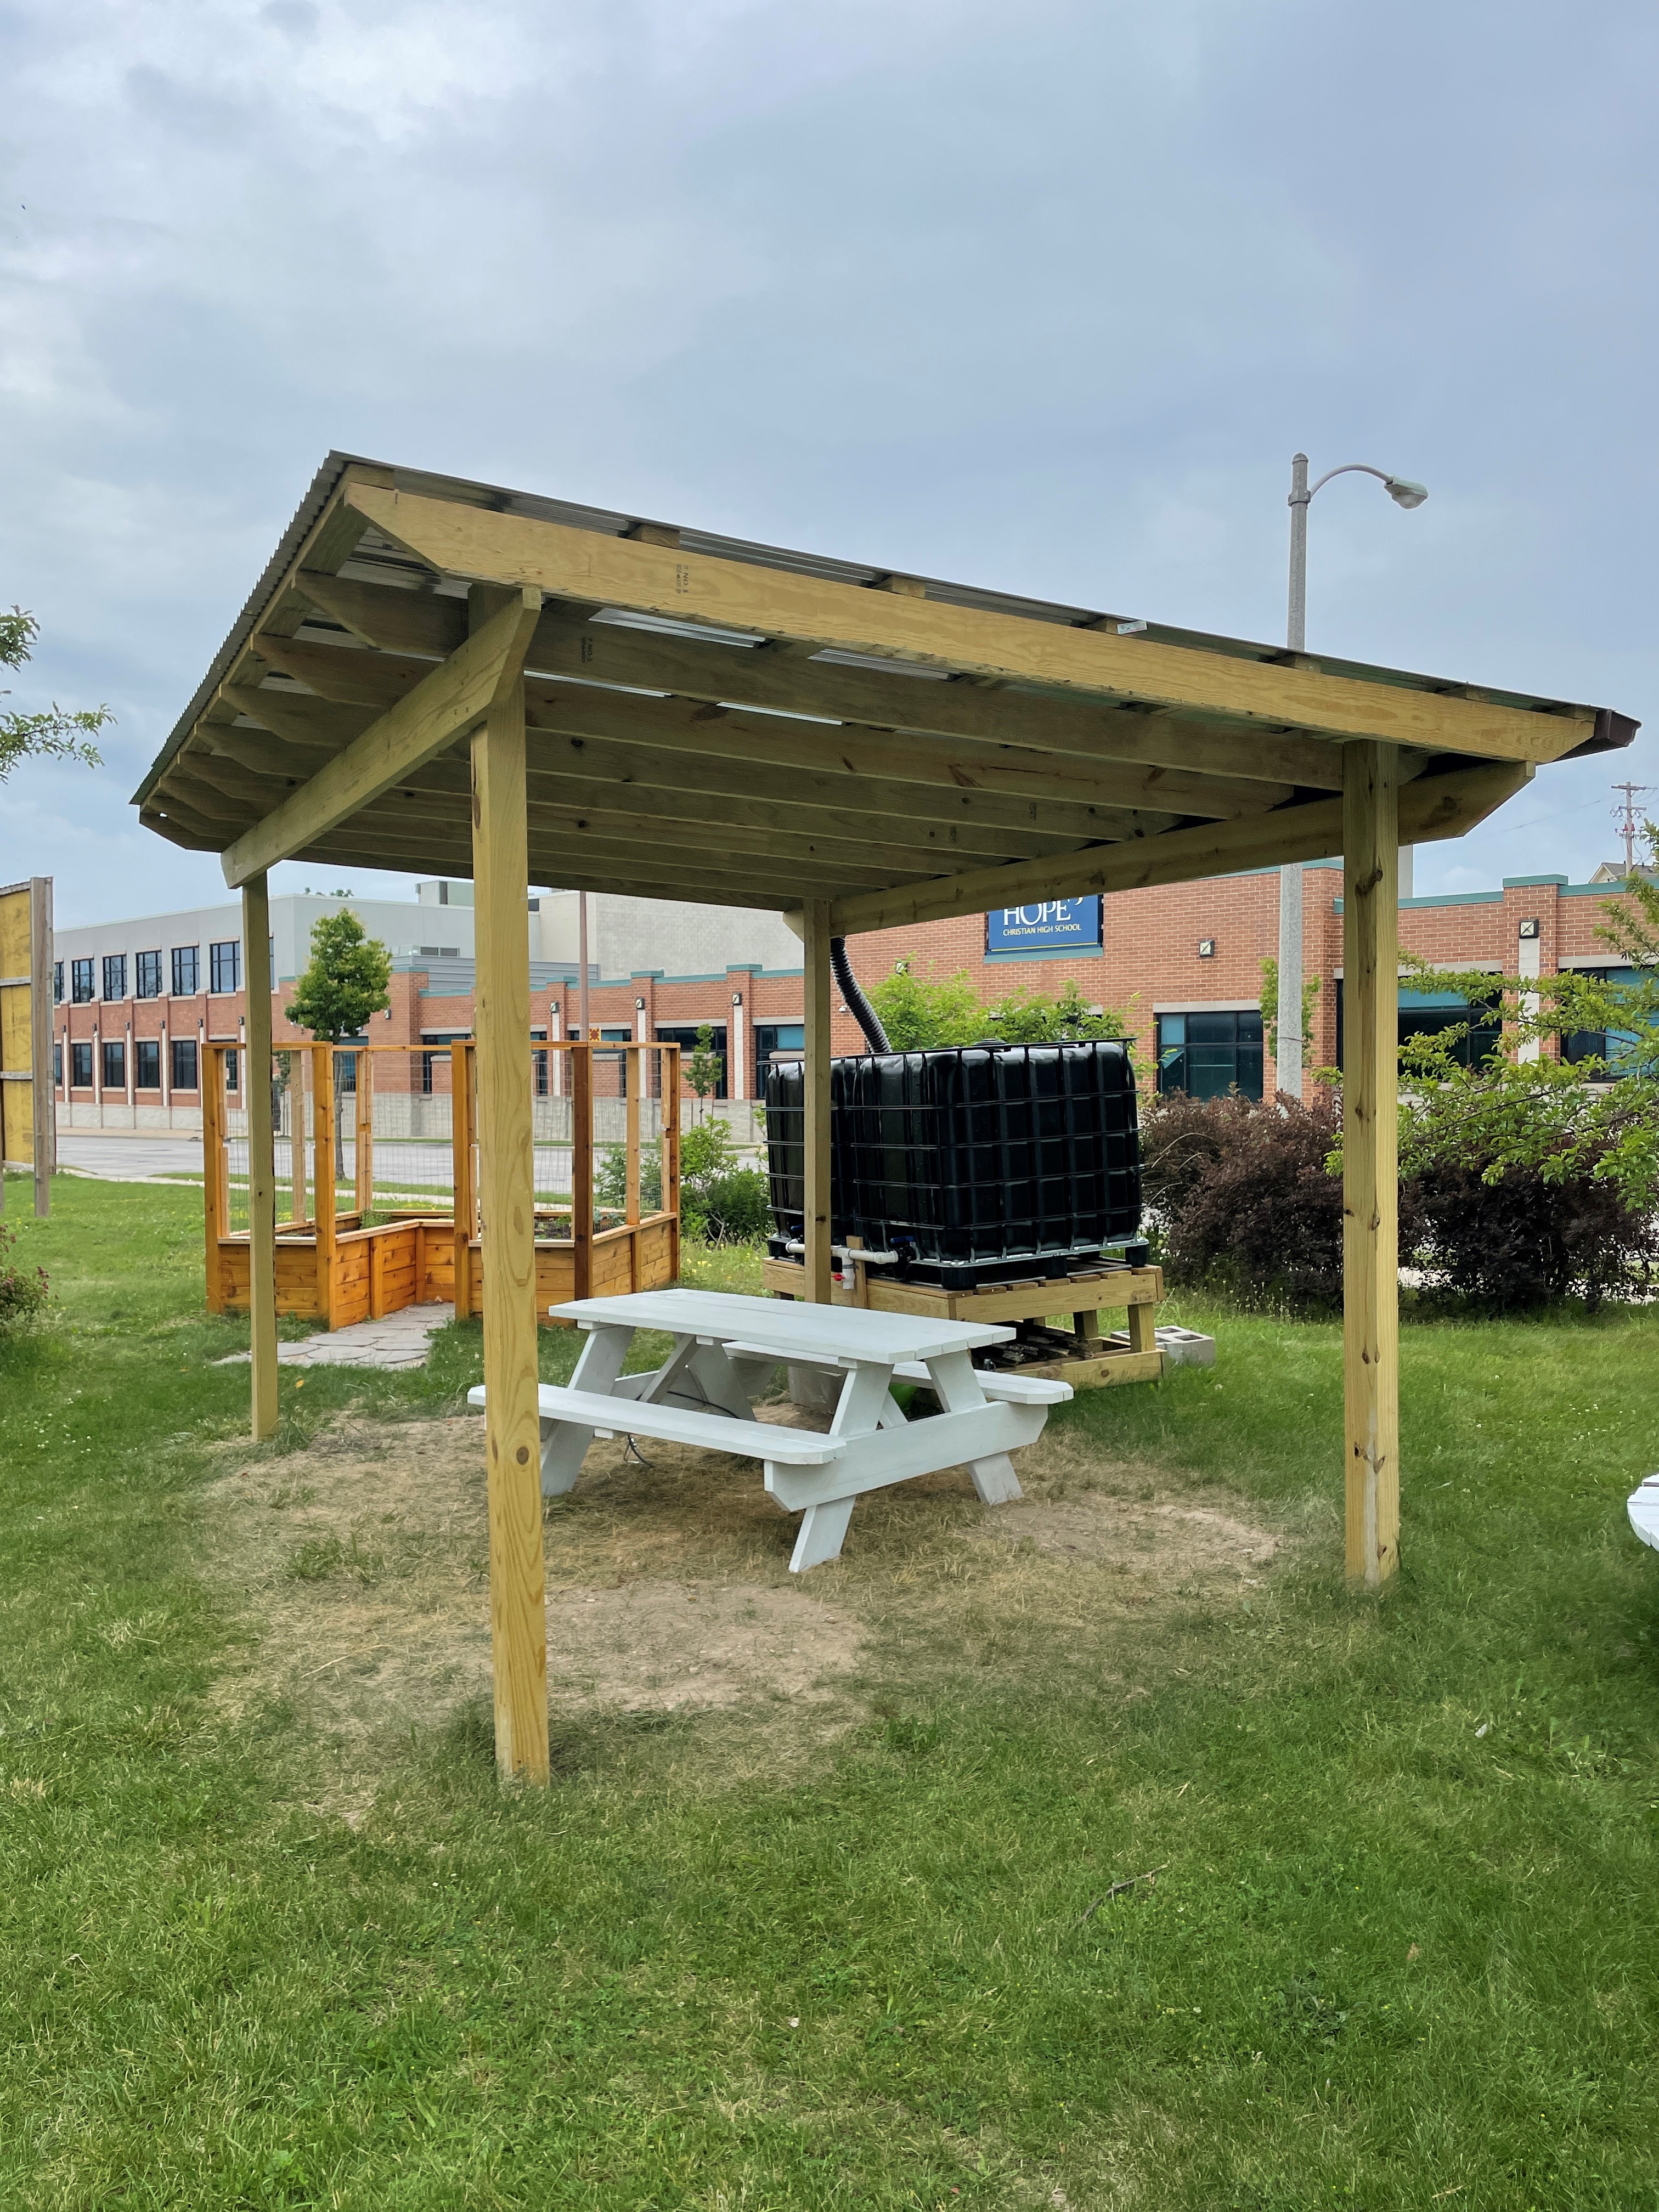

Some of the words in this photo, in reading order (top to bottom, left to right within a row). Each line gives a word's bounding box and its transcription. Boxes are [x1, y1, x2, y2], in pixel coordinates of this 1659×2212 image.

[1003, 899, 1071, 926] HOPE
[1003, 927, 1036, 936] CHRISTIAN
[1037, 925, 1053, 934] HIGH
[1054, 923, 1081, 932] SCHOOL
